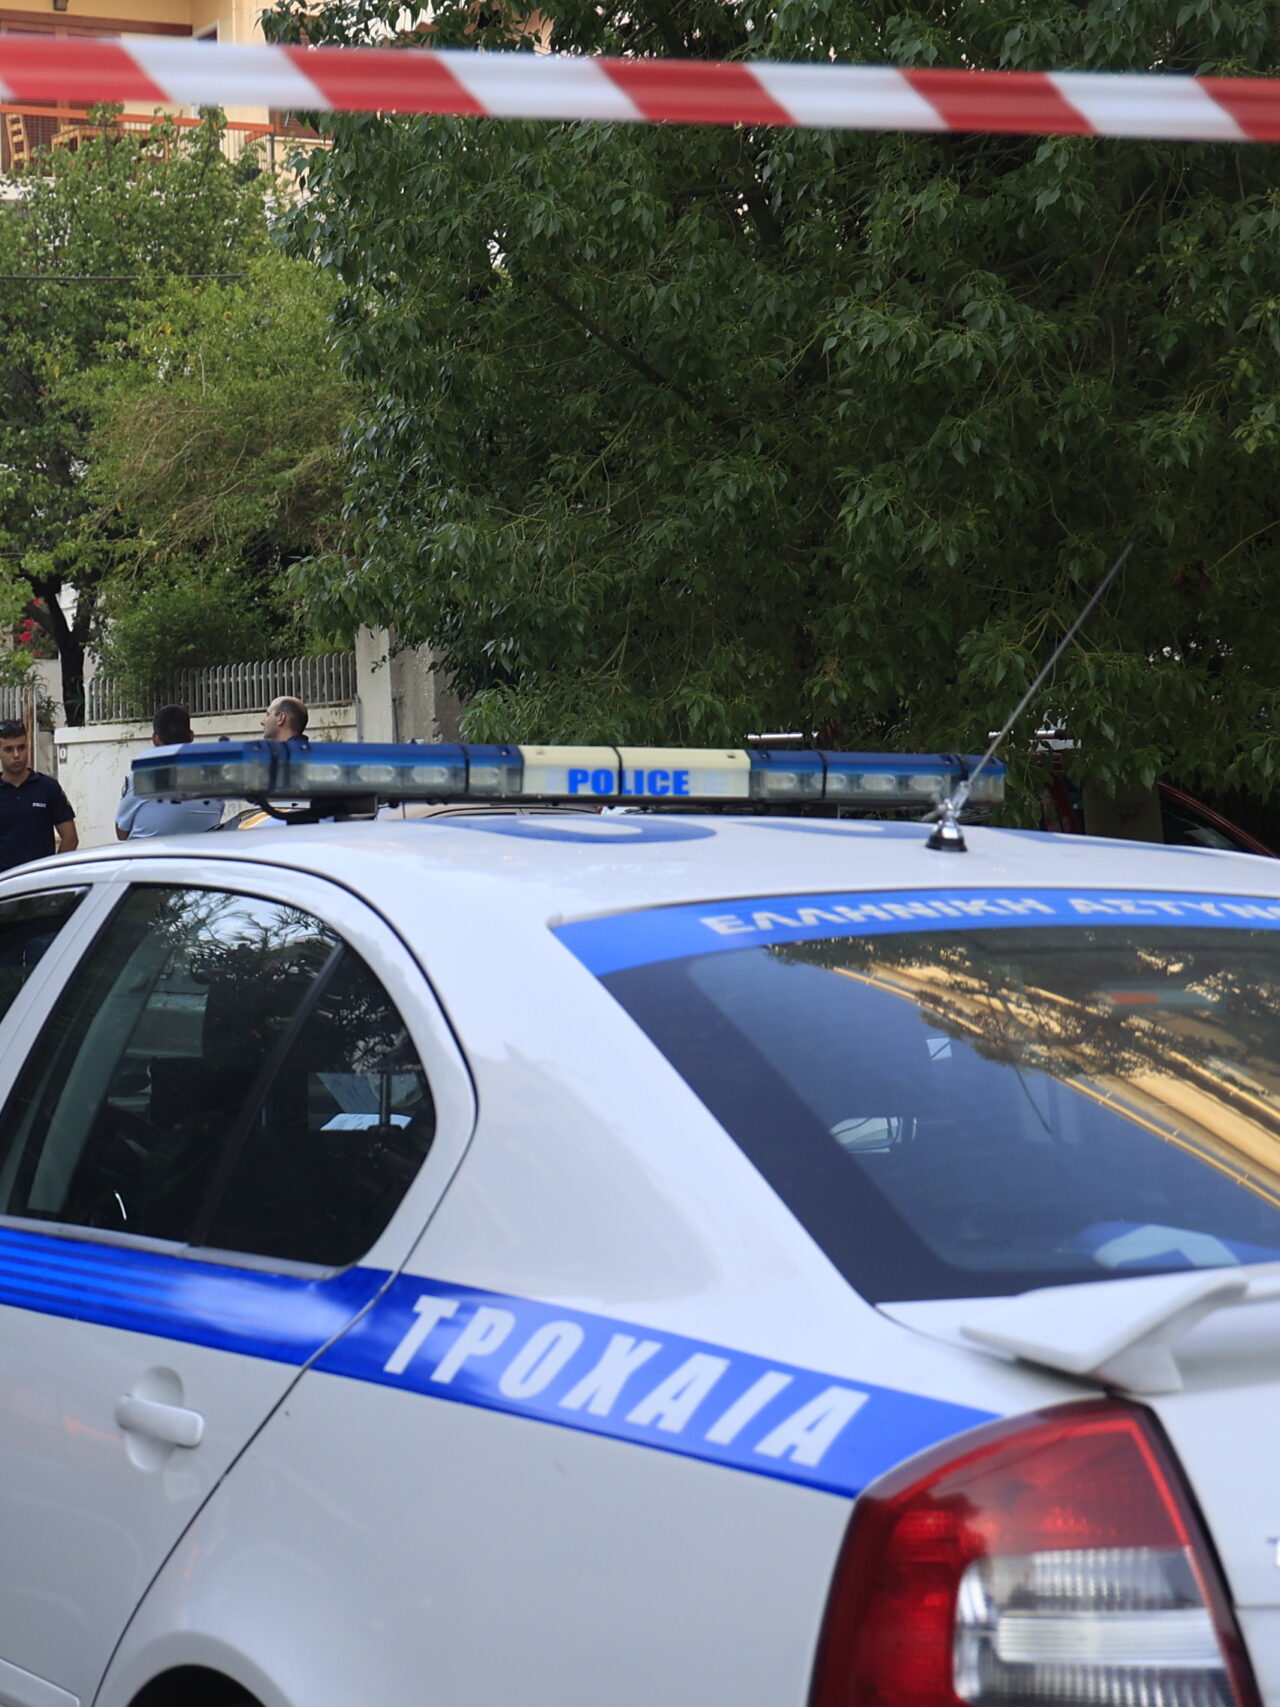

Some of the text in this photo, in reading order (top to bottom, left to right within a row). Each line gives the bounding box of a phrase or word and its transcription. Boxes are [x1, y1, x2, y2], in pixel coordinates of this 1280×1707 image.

[567, 768, 690, 797] POLICE
[700, 897, 1056, 936] ΕΛΛΗΝΙΚΗ
[382, 1294, 871, 1468] ΤΡΟΧΑΙΑ
